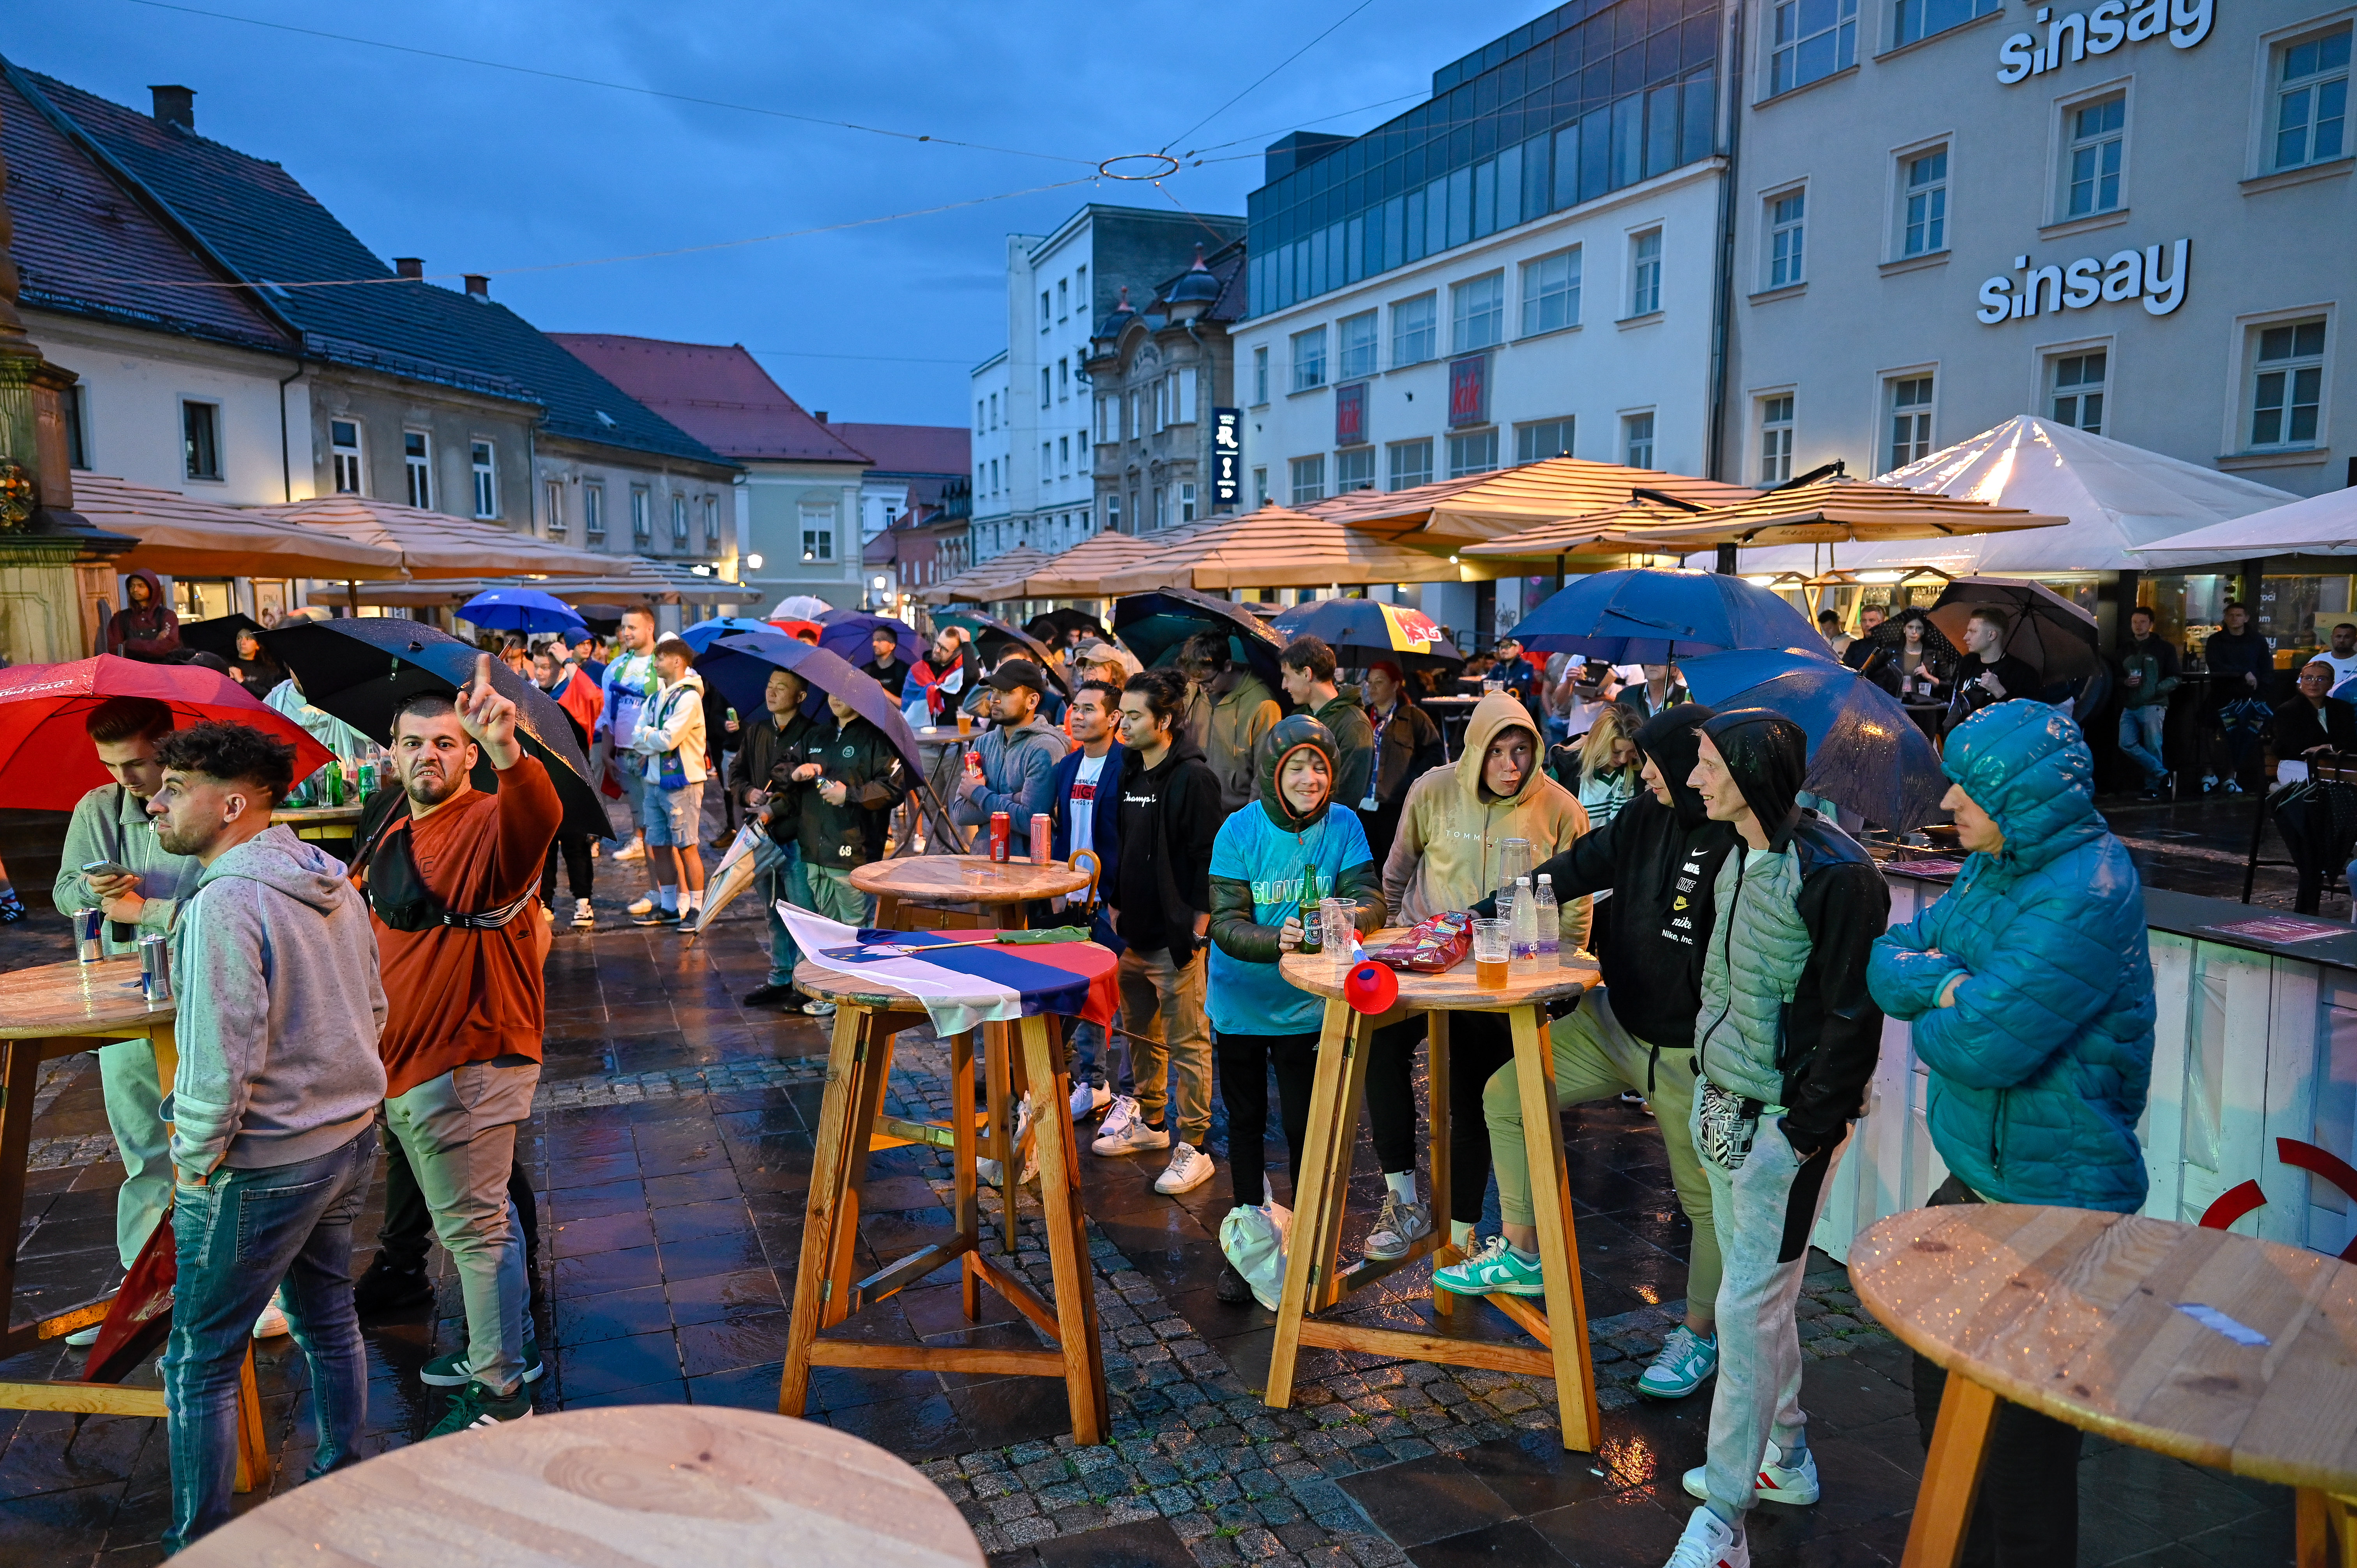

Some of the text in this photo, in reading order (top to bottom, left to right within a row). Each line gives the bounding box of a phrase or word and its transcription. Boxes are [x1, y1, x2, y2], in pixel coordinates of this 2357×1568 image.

[1997, 0, 2214, 84] sinsay
[1977, 238, 2190, 324] sinsay
[1446, 830, 1489, 842] TOMMY
[839, 845, 852, 856] 68
[1682, 862, 1700, 875] NIKE
[1676, 877, 1697, 893] NIKE
[1676, 895, 1687, 905] NIKE
[1662, 929, 1693, 945] Nike, Inc.
[1705, 1523, 1721, 1536] adidas
